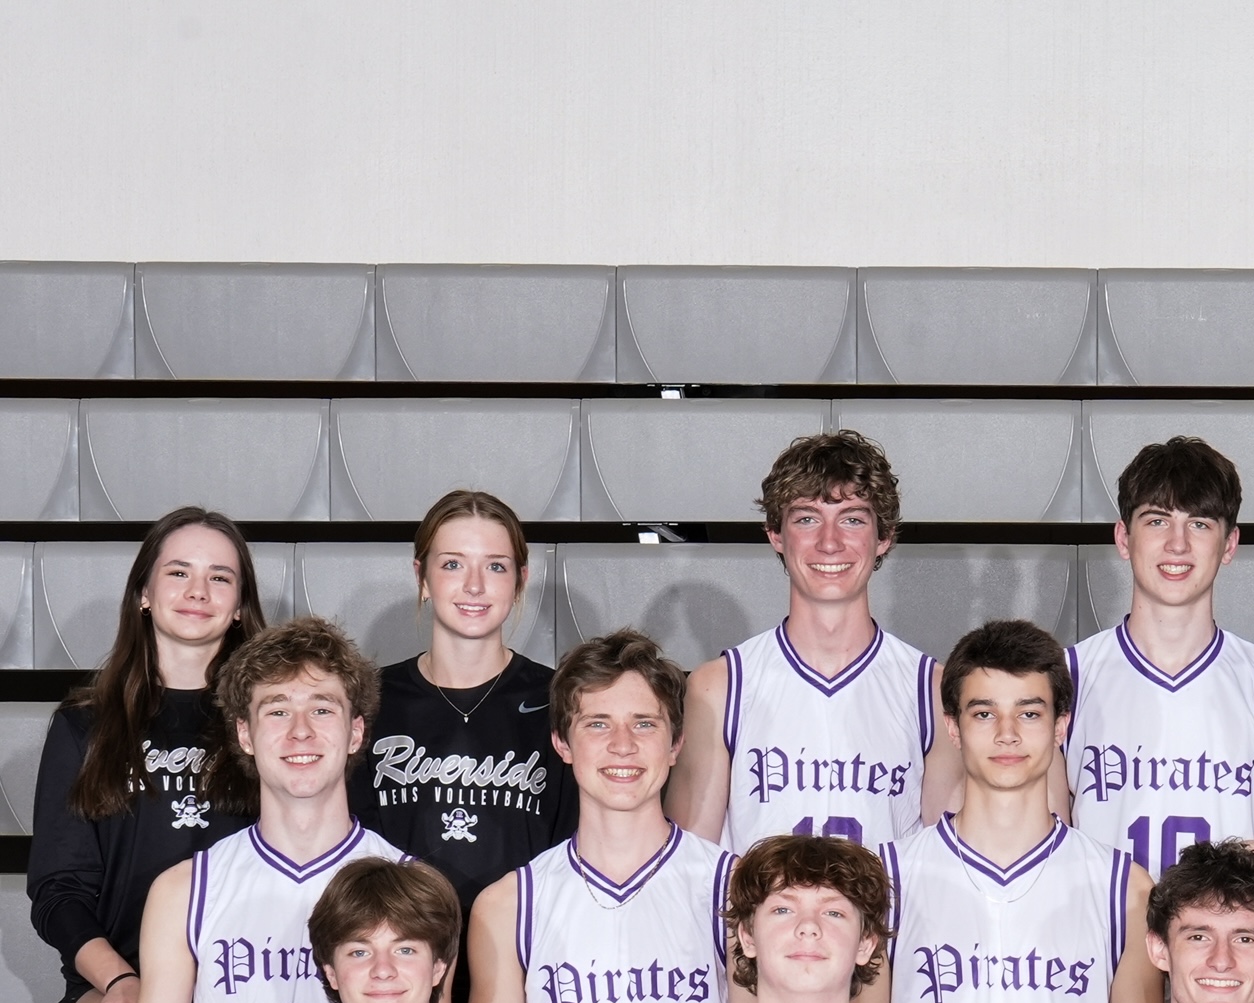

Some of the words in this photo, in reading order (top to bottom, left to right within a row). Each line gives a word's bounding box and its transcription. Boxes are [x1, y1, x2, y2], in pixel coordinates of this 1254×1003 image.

[373, 735, 547, 794] Riverside
[747, 746, 911, 803] Pirates
[1082, 744, 1254, 802] Pirates
[378, 786, 419, 806] MENS
[434, 786, 541, 815] VOLLEYBALL
[213, 937, 324, 994] Pira
